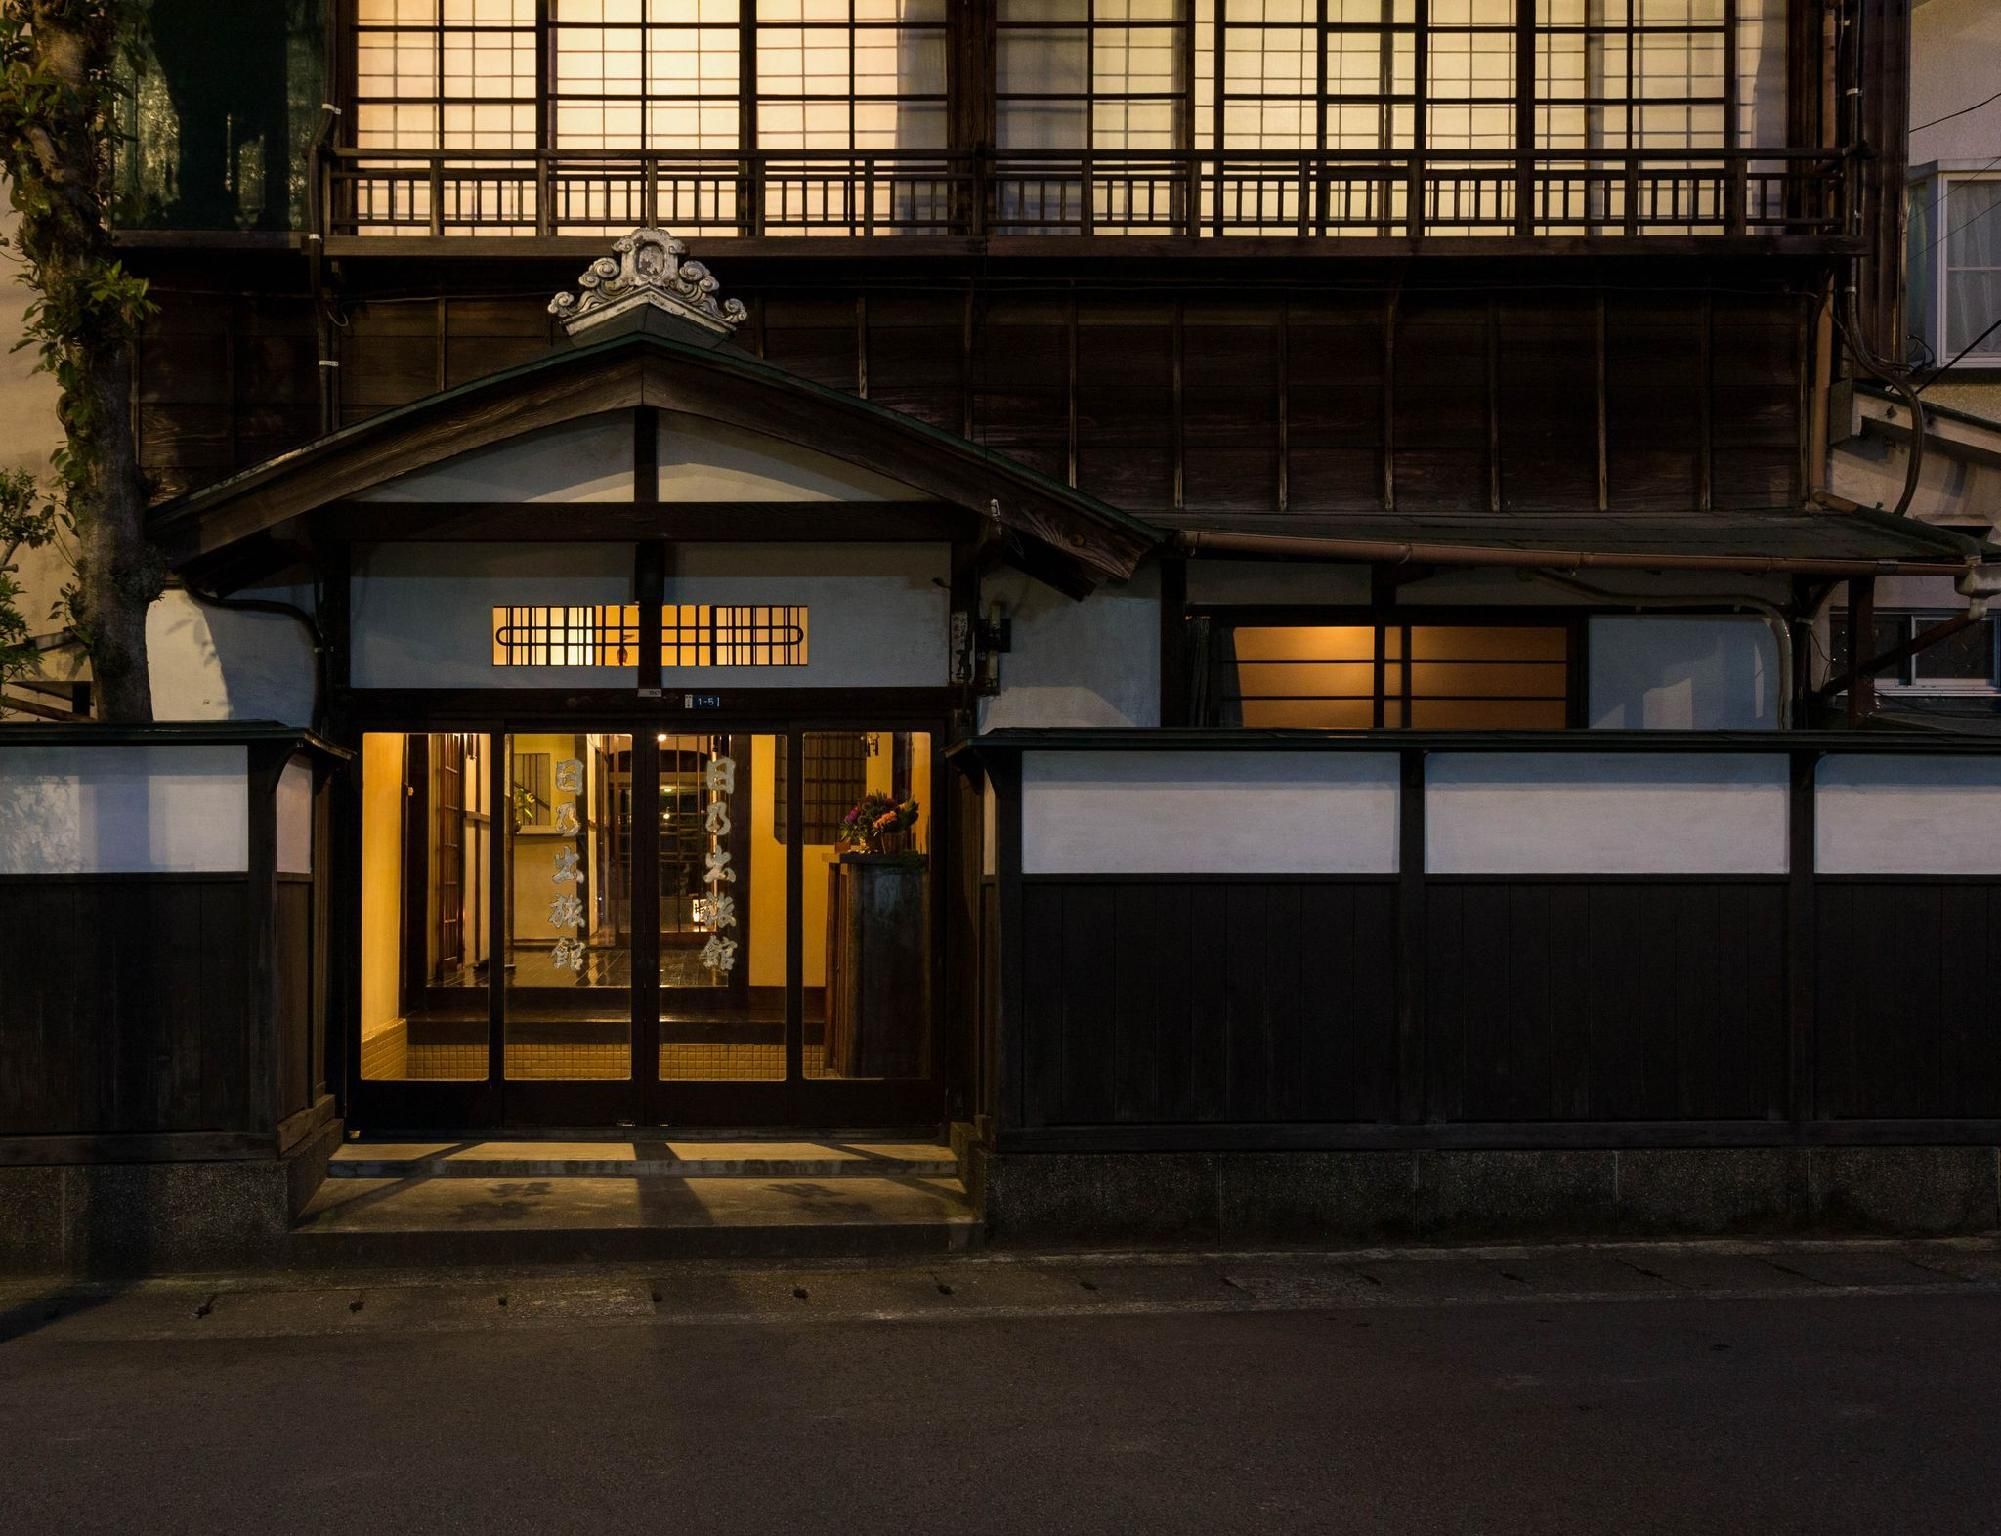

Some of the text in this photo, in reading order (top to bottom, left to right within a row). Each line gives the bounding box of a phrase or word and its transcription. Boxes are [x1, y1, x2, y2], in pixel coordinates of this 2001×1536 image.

[550, 759, 586, 970] 日乃出旅館
[699, 757, 738, 970] 日乃出旅館
